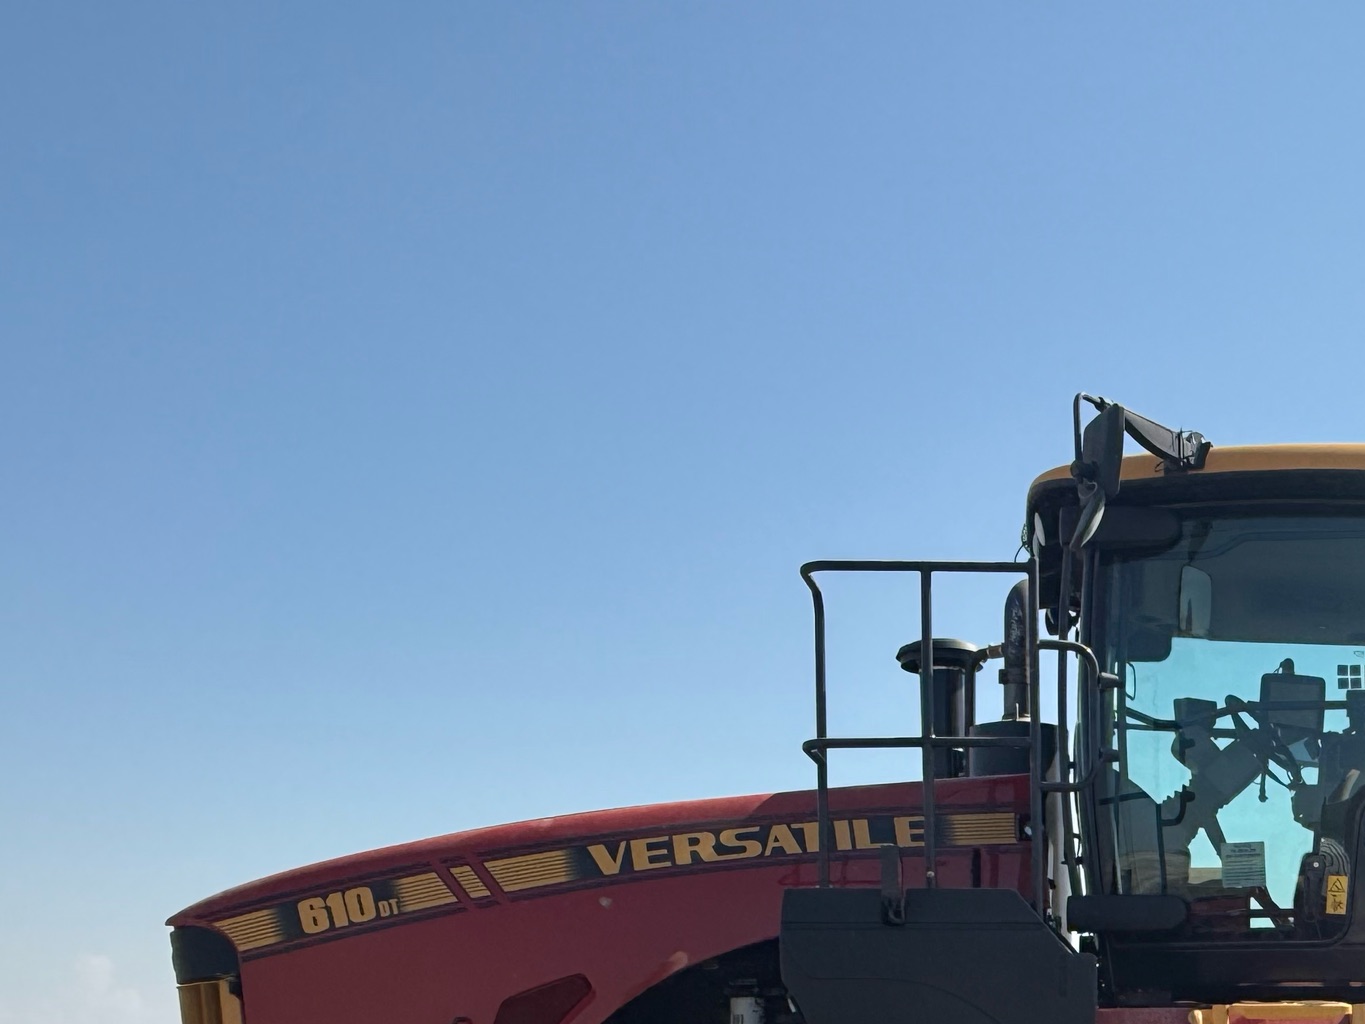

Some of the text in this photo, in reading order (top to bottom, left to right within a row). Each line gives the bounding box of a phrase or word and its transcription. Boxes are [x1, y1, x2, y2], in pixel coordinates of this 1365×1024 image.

[587, 815, 927, 875] VERSATILE
[298, 886, 399, 934] 610 DT
